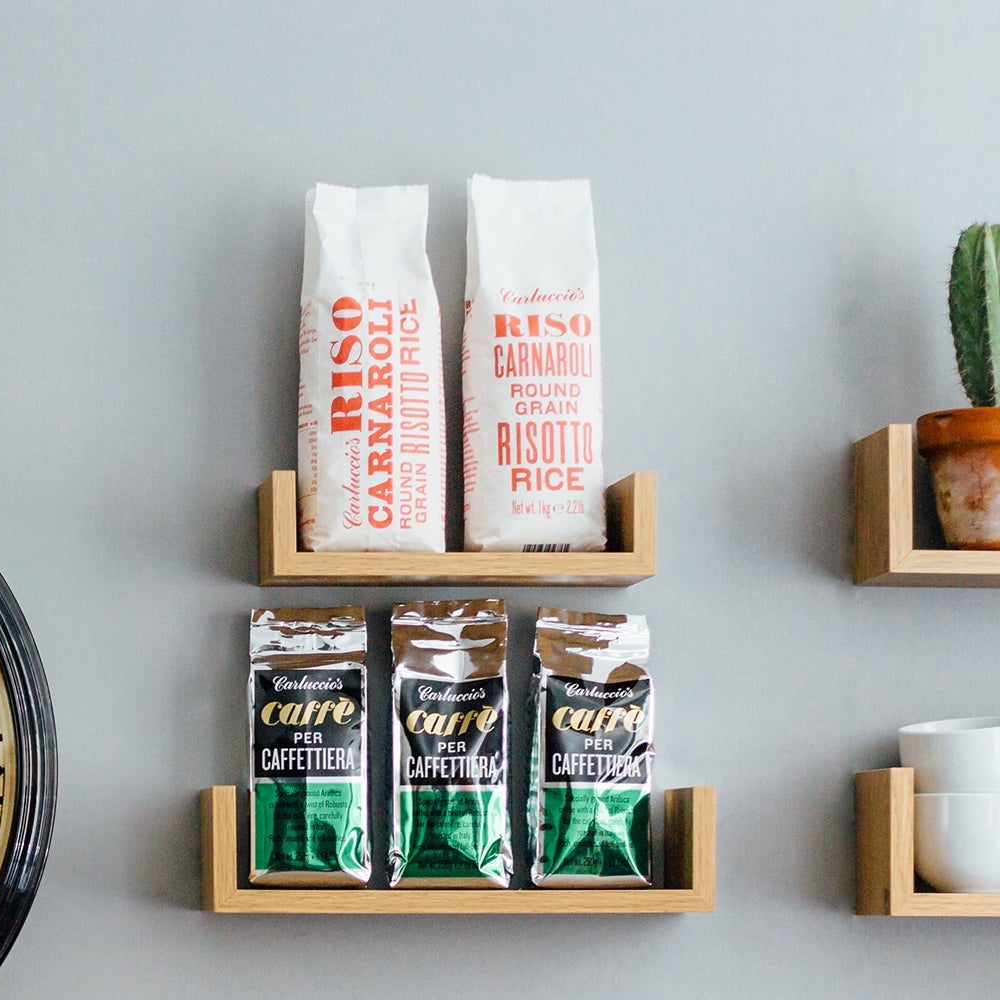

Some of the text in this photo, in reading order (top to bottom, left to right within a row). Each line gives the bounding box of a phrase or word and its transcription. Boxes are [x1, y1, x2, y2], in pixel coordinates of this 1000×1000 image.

[499, 287, 585, 305] Carluccio's
[493, 313, 592, 339] RISO
[330, 296, 364, 434] RISO
[494, 342, 593, 379] CARNAROLI
[399, 298, 430, 455] RISOTTO RICE
[510, 383, 581, 399] ROUND
[367, 299, 393, 529] CARNAROLI
[515, 401, 578, 416] GRAIN
[497, 421, 593, 466] RISOTTO
[342, 437, 361, 529] Carluccio's
[511, 467, 585, 492] RICE
[399, 461, 412, 529] ROUND
[415, 463, 427, 523] GRAIN
[273, 675, 343, 692] Carluccio's
[418, 685, 486, 702] Carluccio's
[564, 682, 634, 699] Carluccio's
[294, 732, 323, 744] PER
[438, 741, 466, 753] PER
[584, 739, 613, 750] PER
[261, 747, 355, 770] CAFFETTIERA
[406, 756, 497, 778] CAFFETTIERA
[552, 753, 641, 777] CAFFETTIERA
